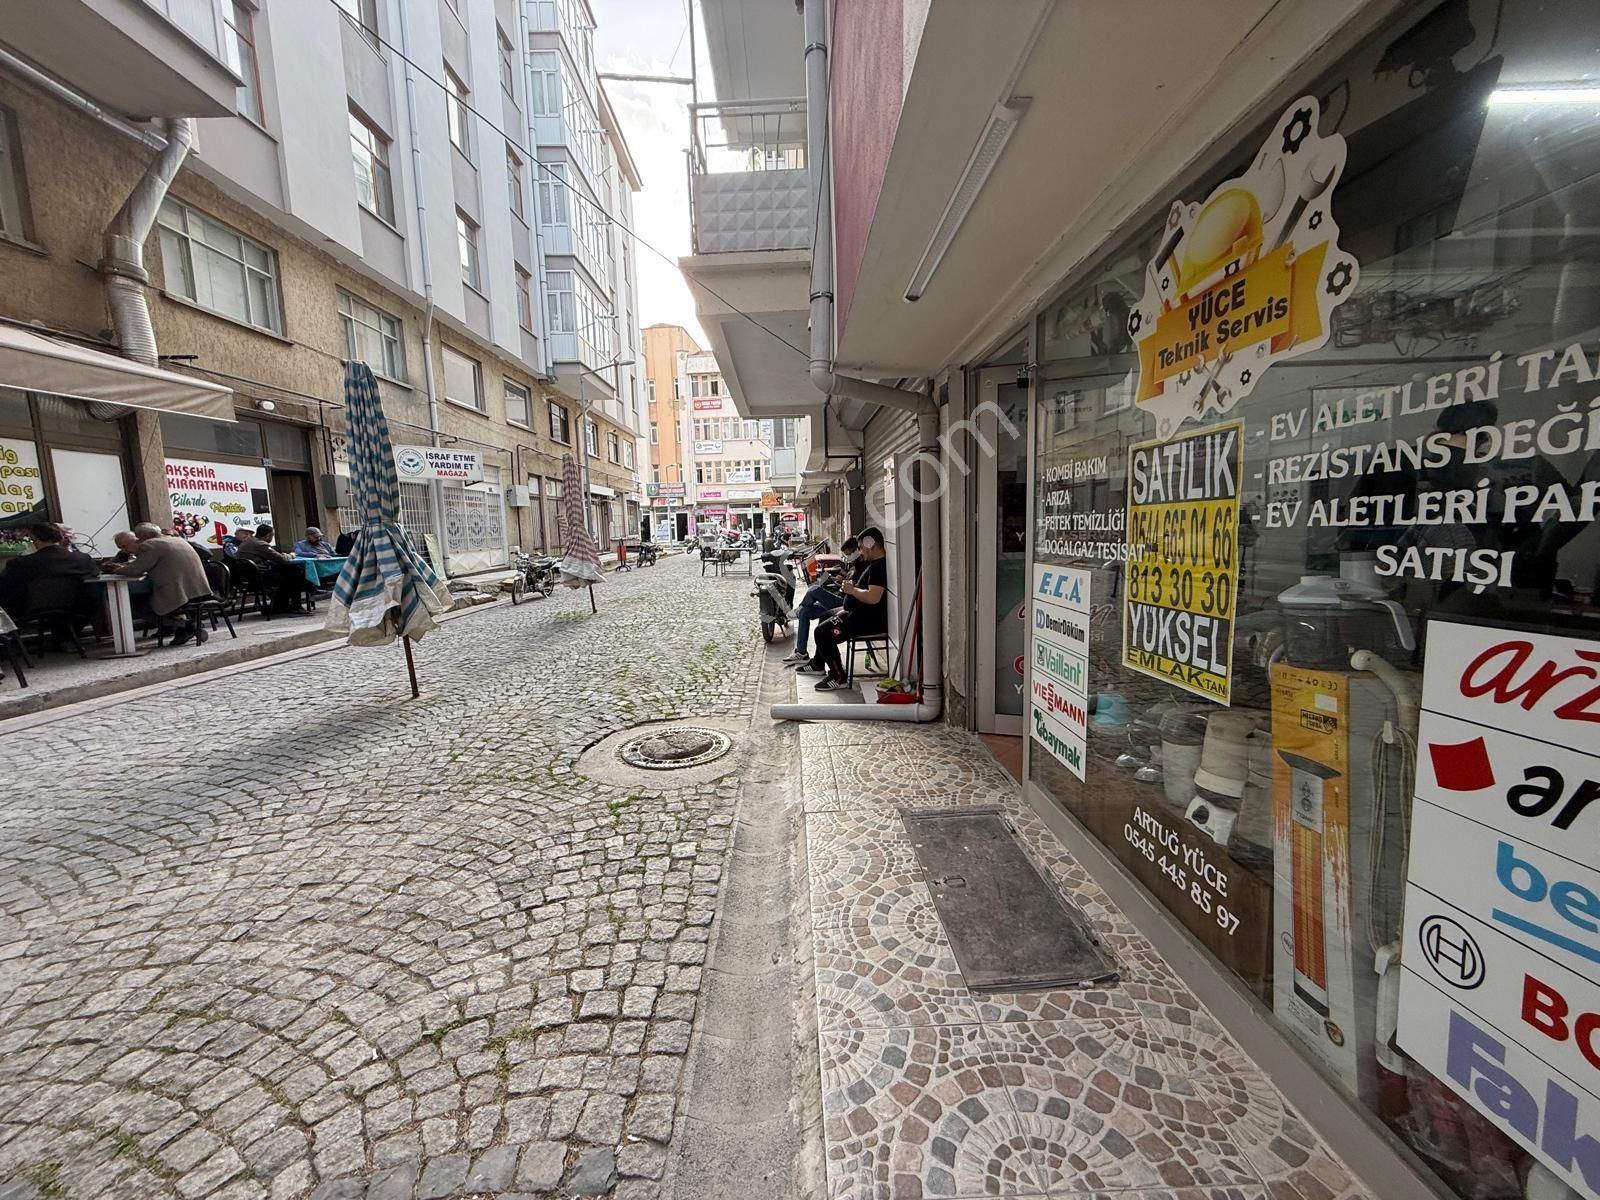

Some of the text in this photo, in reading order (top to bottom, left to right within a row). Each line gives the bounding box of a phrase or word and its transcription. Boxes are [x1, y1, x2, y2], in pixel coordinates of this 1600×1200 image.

[1188, 279, 1246, 331] YÜCE
[1158, 296, 1288, 369] Teknik Servis
[1271, 408, 1307, 441] EV
[1312, 351, 1503, 433] ALETLERİ
[165, 464, 215, 480] AKŞEHİR
[426, 451, 476, 462] İSRAF ETME
[428, 461, 462, 470] YARDIM
[436, 469, 468, 477] MAĞAZA
[1046, 456, 1107, 483] KOMBİ BAKIM
[1132, 430, 1237, 504] SATILIK
[1268, 431, 1453, 485] REZİSTANS
[167, 478, 248, 492] KIRAATHANESİ
[170, 492, 206, 507] Bilardo
[1046, 489, 1070, 506] ARIZA
[1266, 500, 1302, 528] EV
[1306, 477, 1491, 528] ALETLERİ
[1046, 507, 1125, 531] PETEK TEMİZLİĞİ
[1162, 509, 1187, 565] 665
[1191, 507, 1208, 567] 01
[1212, 506, 1232, 569] 66
[1046, 538, 1147, 562] DOĞALGAZ TESİSAT
[1373, 545, 1516, 595] SATIŞI
[1130, 564, 1230, 616] 813 30 30
[1045, 613, 1085, 643] DemirDöküm
[1128, 602, 1227, 676] YÜKSEL
[1045, 648, 1081, 686] Vaillant
[1042, 722, 1081, 771] baymak
[1133, 806, 1228, 898] ARTUĞ YÜCE
[1124, 823, 1240, 936] 0545 445 85 97
